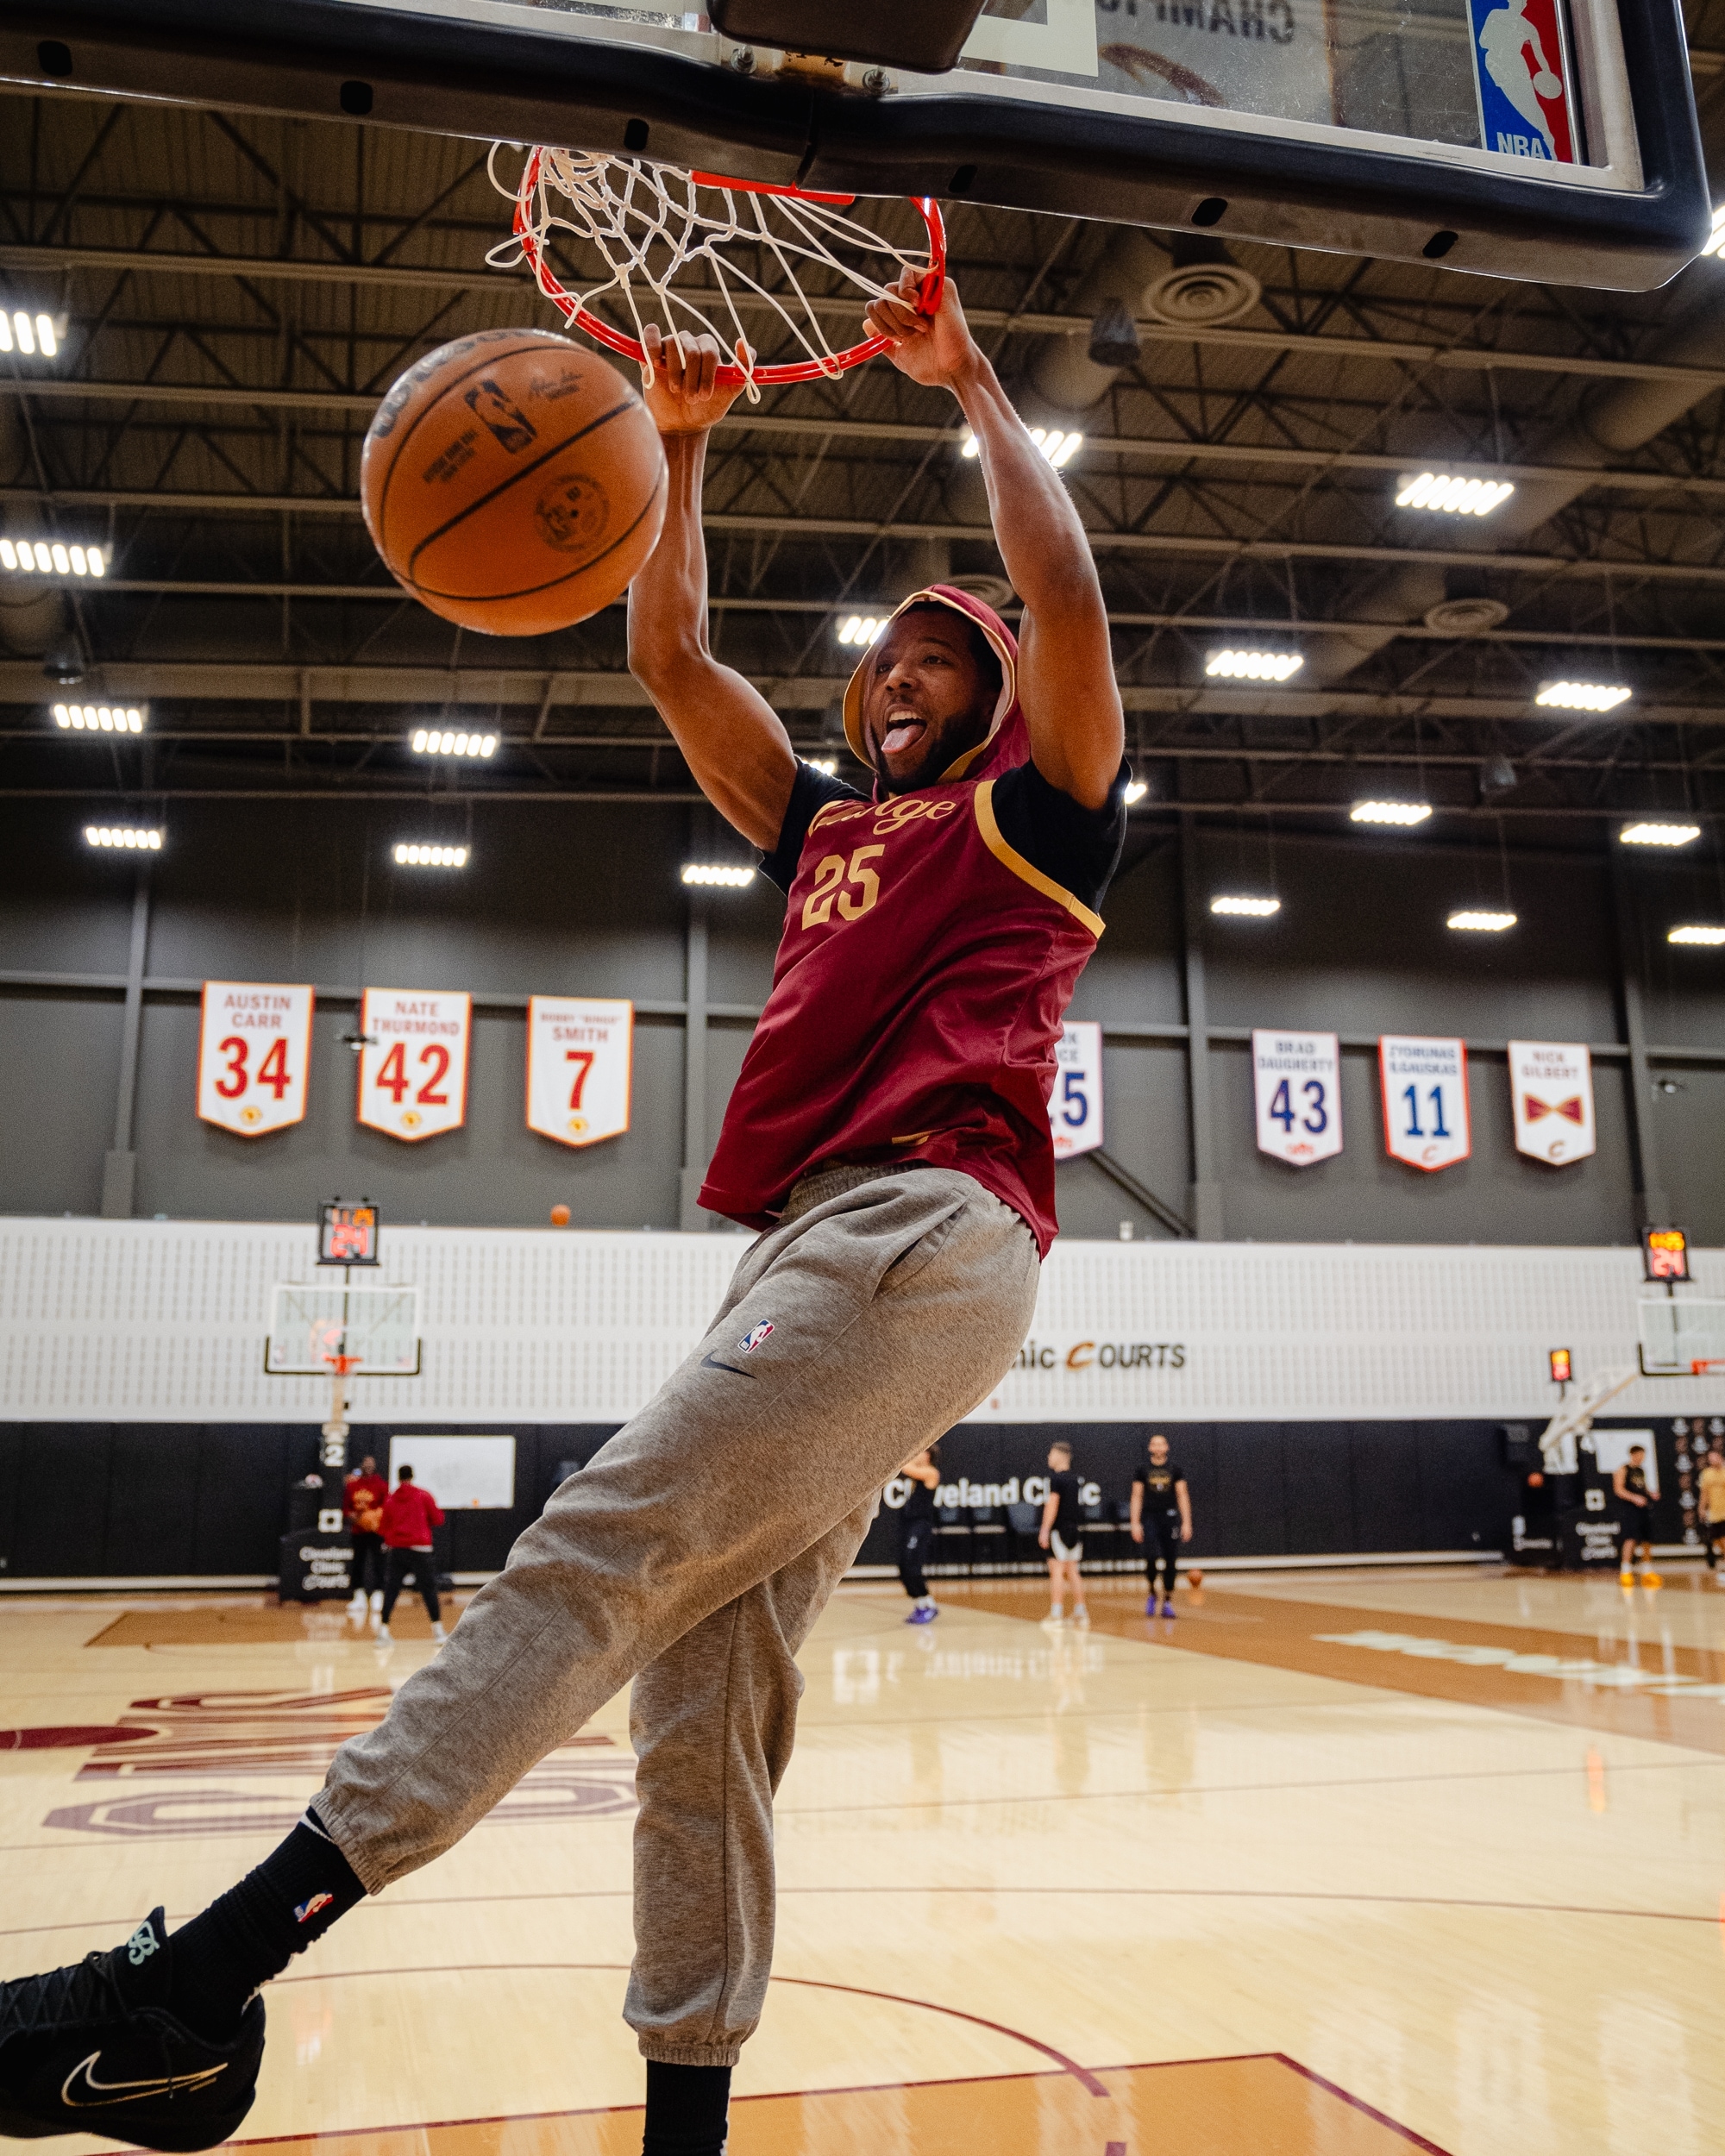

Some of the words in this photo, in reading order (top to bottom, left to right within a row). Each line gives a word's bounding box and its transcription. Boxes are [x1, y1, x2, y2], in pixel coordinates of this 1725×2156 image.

[1496, 132, 1546, 160] NBA
[802, 844, 886, 931] 25
[224, 994, 292, 1010] AUSTIN
[395, 1001, 439, 1017] NATE
[231, 1012, 282, 1028] CARR
[373, 1018, 460, 1036] THURMOND
[553, 1026, 609, 1043] SMITH
[214, 1036, 292, 1100] 34
[376, 1042, 449, 1105] 42
[565, 1050, 594, 1110] 7
[1050, 1072, 1088, 1127] 5
[1270, 1079, 1327, 1133] 43
[1404, 1085, 1451, 1137] 11
[330, 1224, 368, 1257] 24
[1013, 1340, 1056, 1369] nic
[324, 1444, 345, 1467] 2
